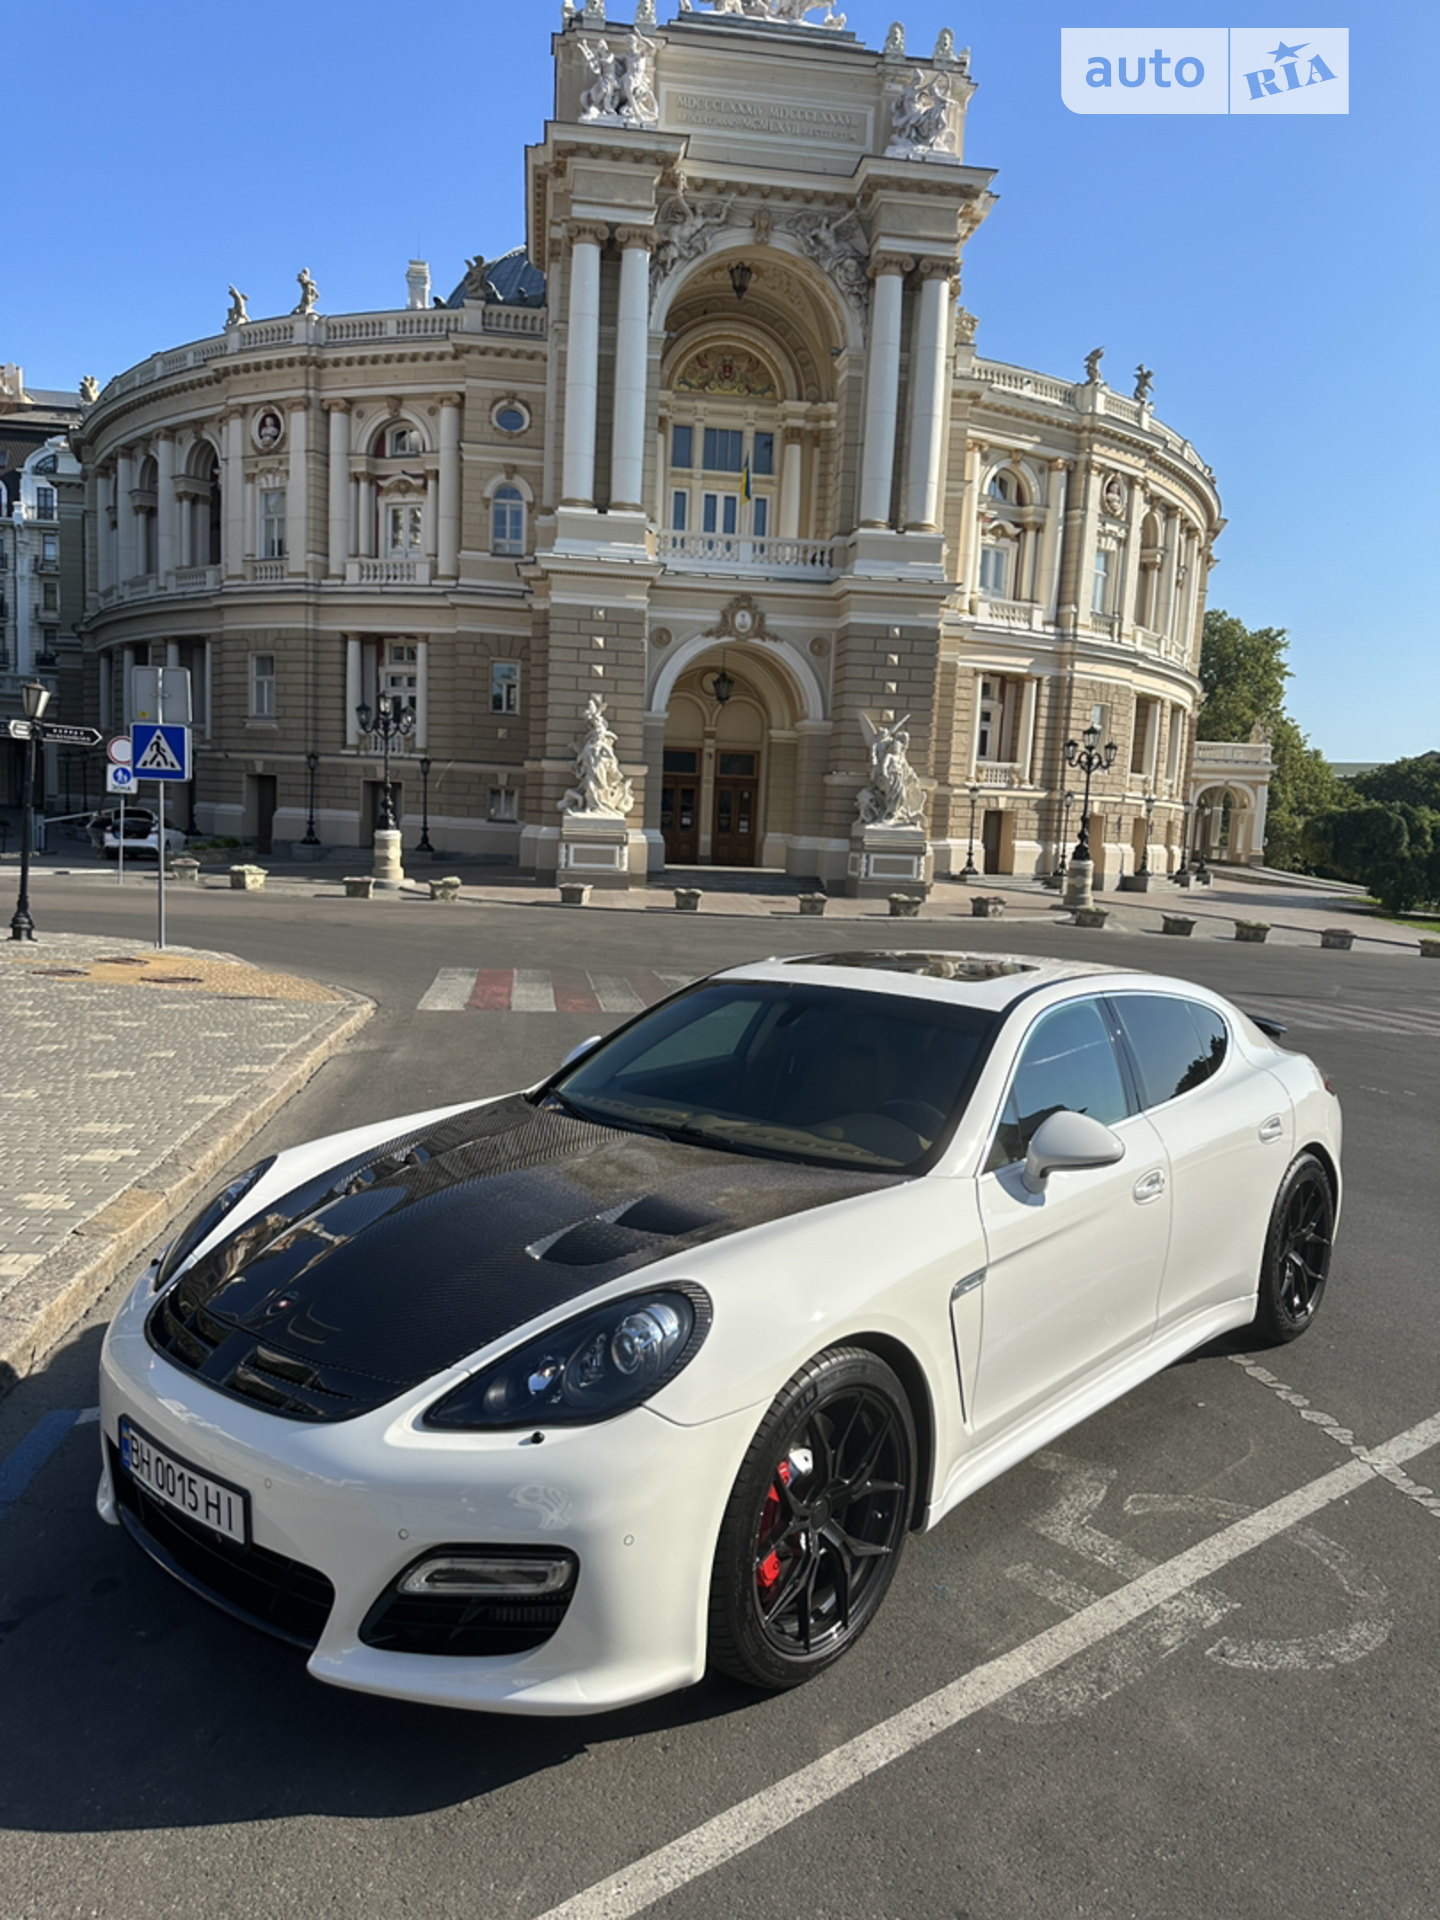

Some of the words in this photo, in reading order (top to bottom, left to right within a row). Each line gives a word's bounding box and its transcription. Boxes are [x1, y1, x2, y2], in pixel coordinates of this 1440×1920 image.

[130, 1434, 150, 1480] BH
[155, 1455, 198, 1512] 0015
[204, 1485, 233, 1531] HI
